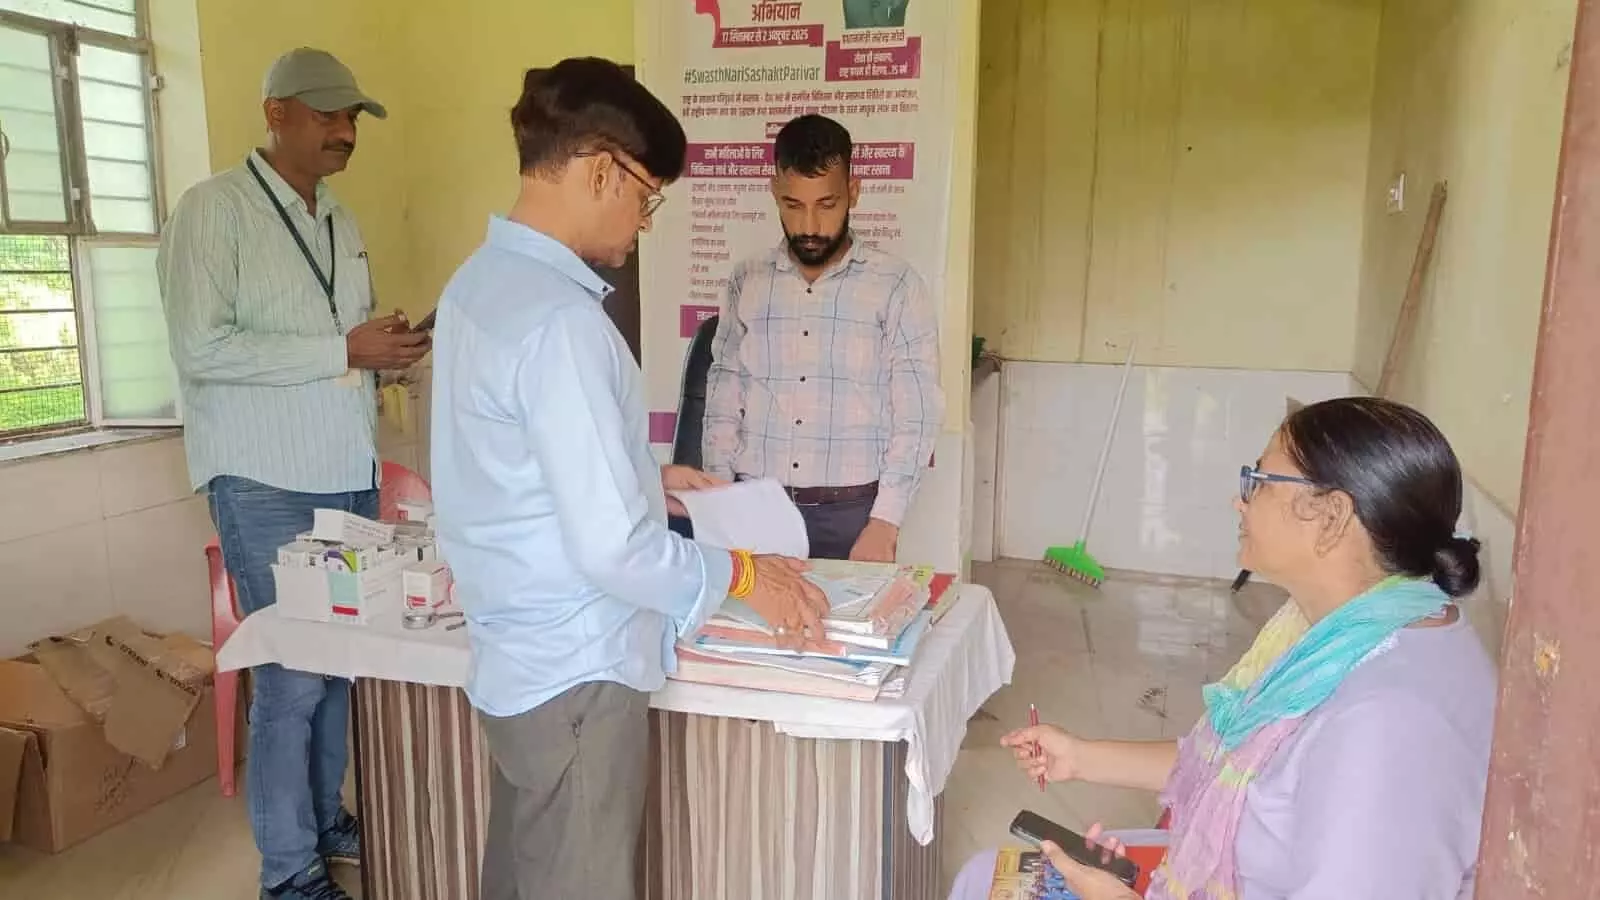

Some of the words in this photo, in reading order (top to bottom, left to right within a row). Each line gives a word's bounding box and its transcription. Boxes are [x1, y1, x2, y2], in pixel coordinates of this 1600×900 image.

[763, 31, 767, 41] 2
[791, 28, 808, 40] 2025
[684, 64, 820, 84] #SwasthNariSashaktParivar
